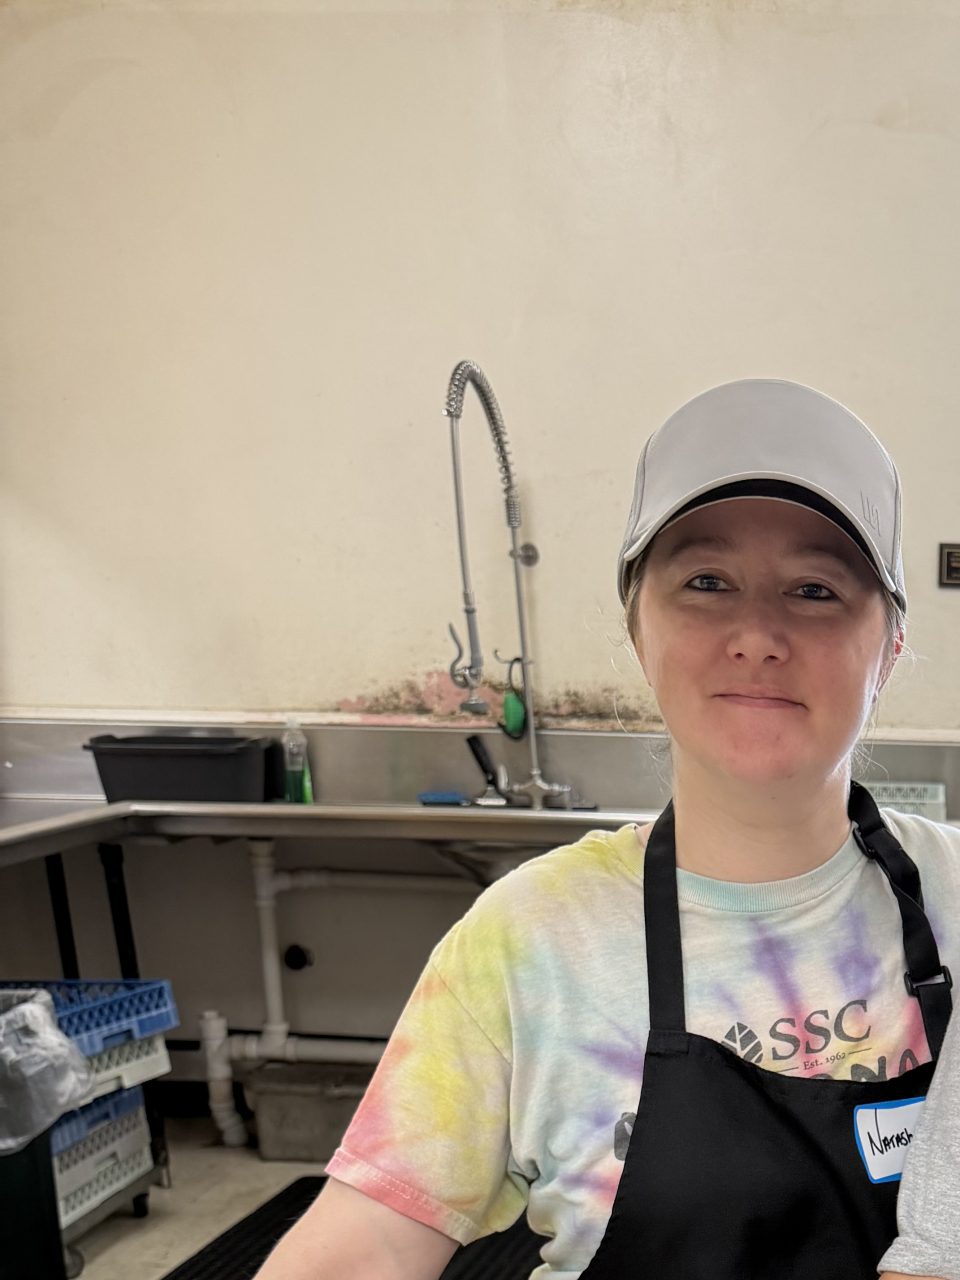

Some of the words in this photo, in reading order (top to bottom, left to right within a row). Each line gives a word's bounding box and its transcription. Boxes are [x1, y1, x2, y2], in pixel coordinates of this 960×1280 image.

[768, 999, 872, 1061] SSC
[803, 1058, 823, 1070] Est.
[825, 1052, 846, 1064] 1962
